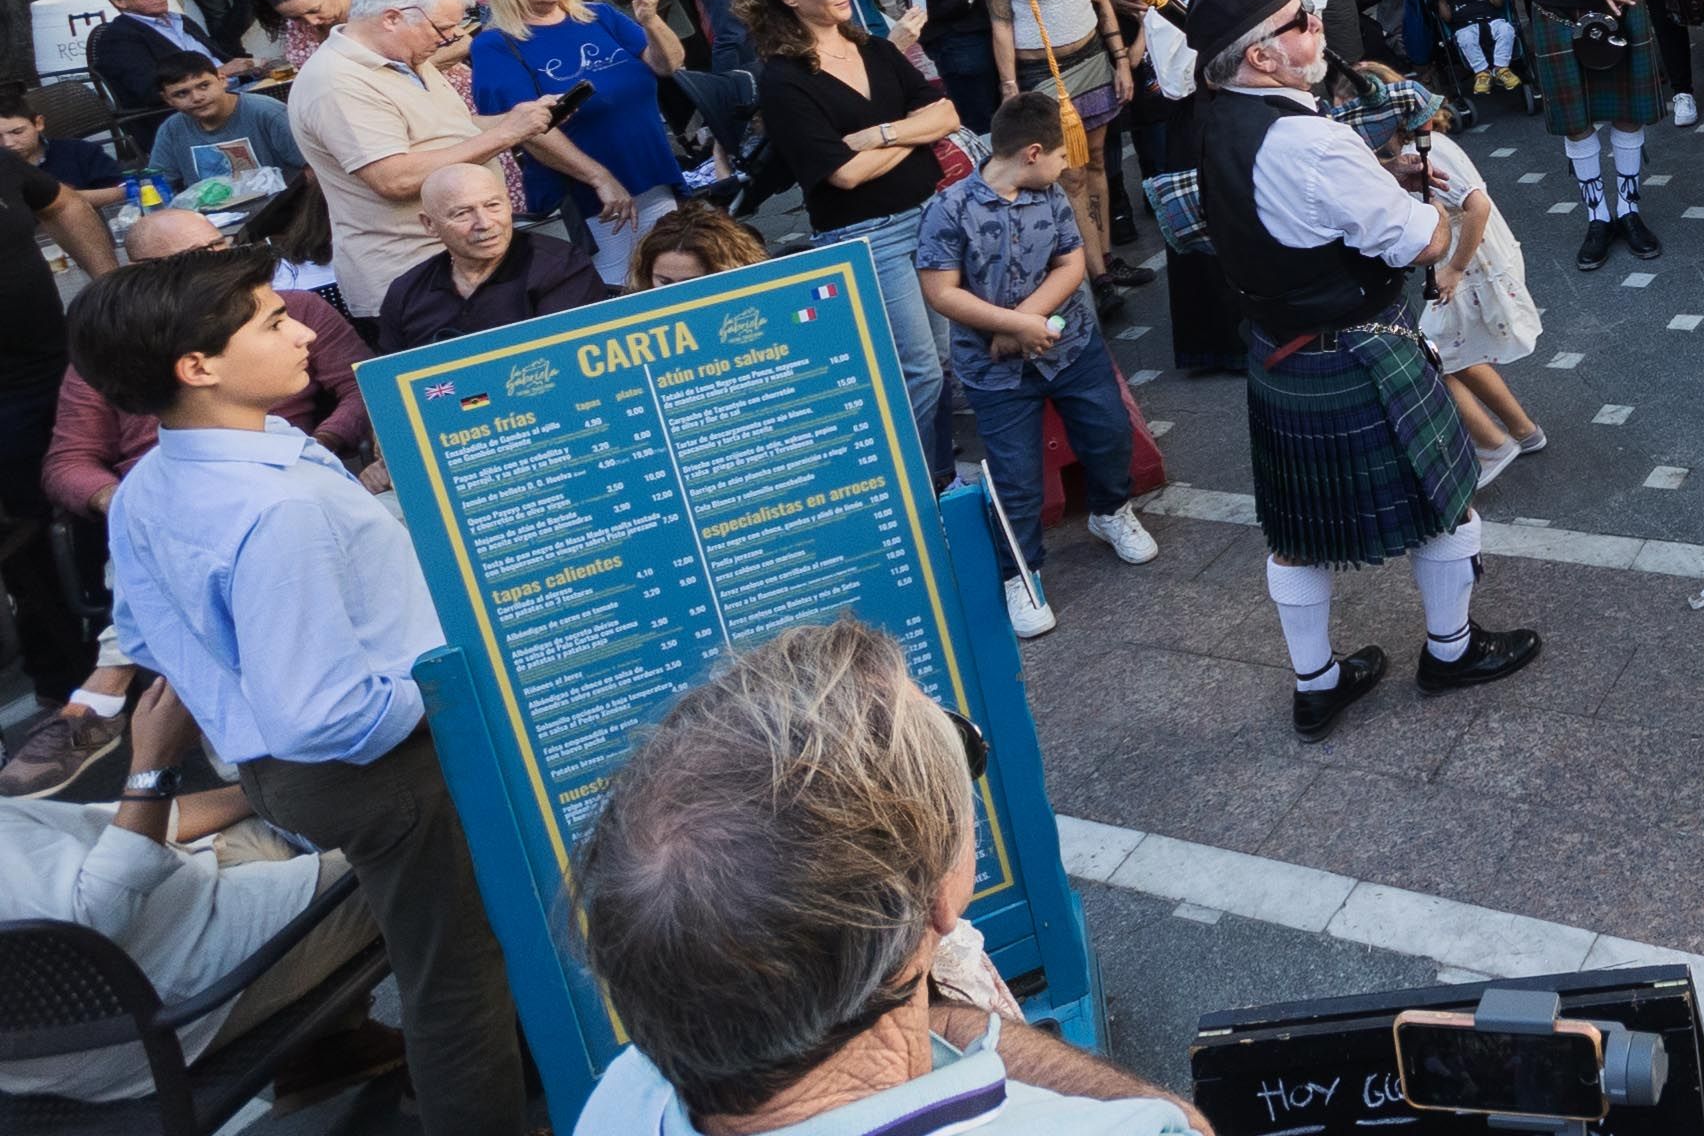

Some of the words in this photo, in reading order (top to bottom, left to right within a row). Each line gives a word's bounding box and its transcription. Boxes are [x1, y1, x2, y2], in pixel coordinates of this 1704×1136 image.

[57, 40, 88, 62] RES
[577, 321, 699, 377] CARTA
[656, 367, 694, 388] atún
[697, 359, 730, 377] rojo
[733, 342, 789, 367] salvaje
[575, 399, 601, 410] tapas
[439, 424, 491, 447] tapas
[494, 411, 536, 432] frías
[701, 500, 803, 539] especialistas
[806, 493, 825, 507] en
[829, 476, 885, 501] arroces
[492, 580, 541, 604] tapas
[545, 555, 622, 588] calientes
[559, 777, 605, 804] nuest
[1257, 1077, 1340, 1121] HOY
[1363, 1074, 1404, 1108] GU
